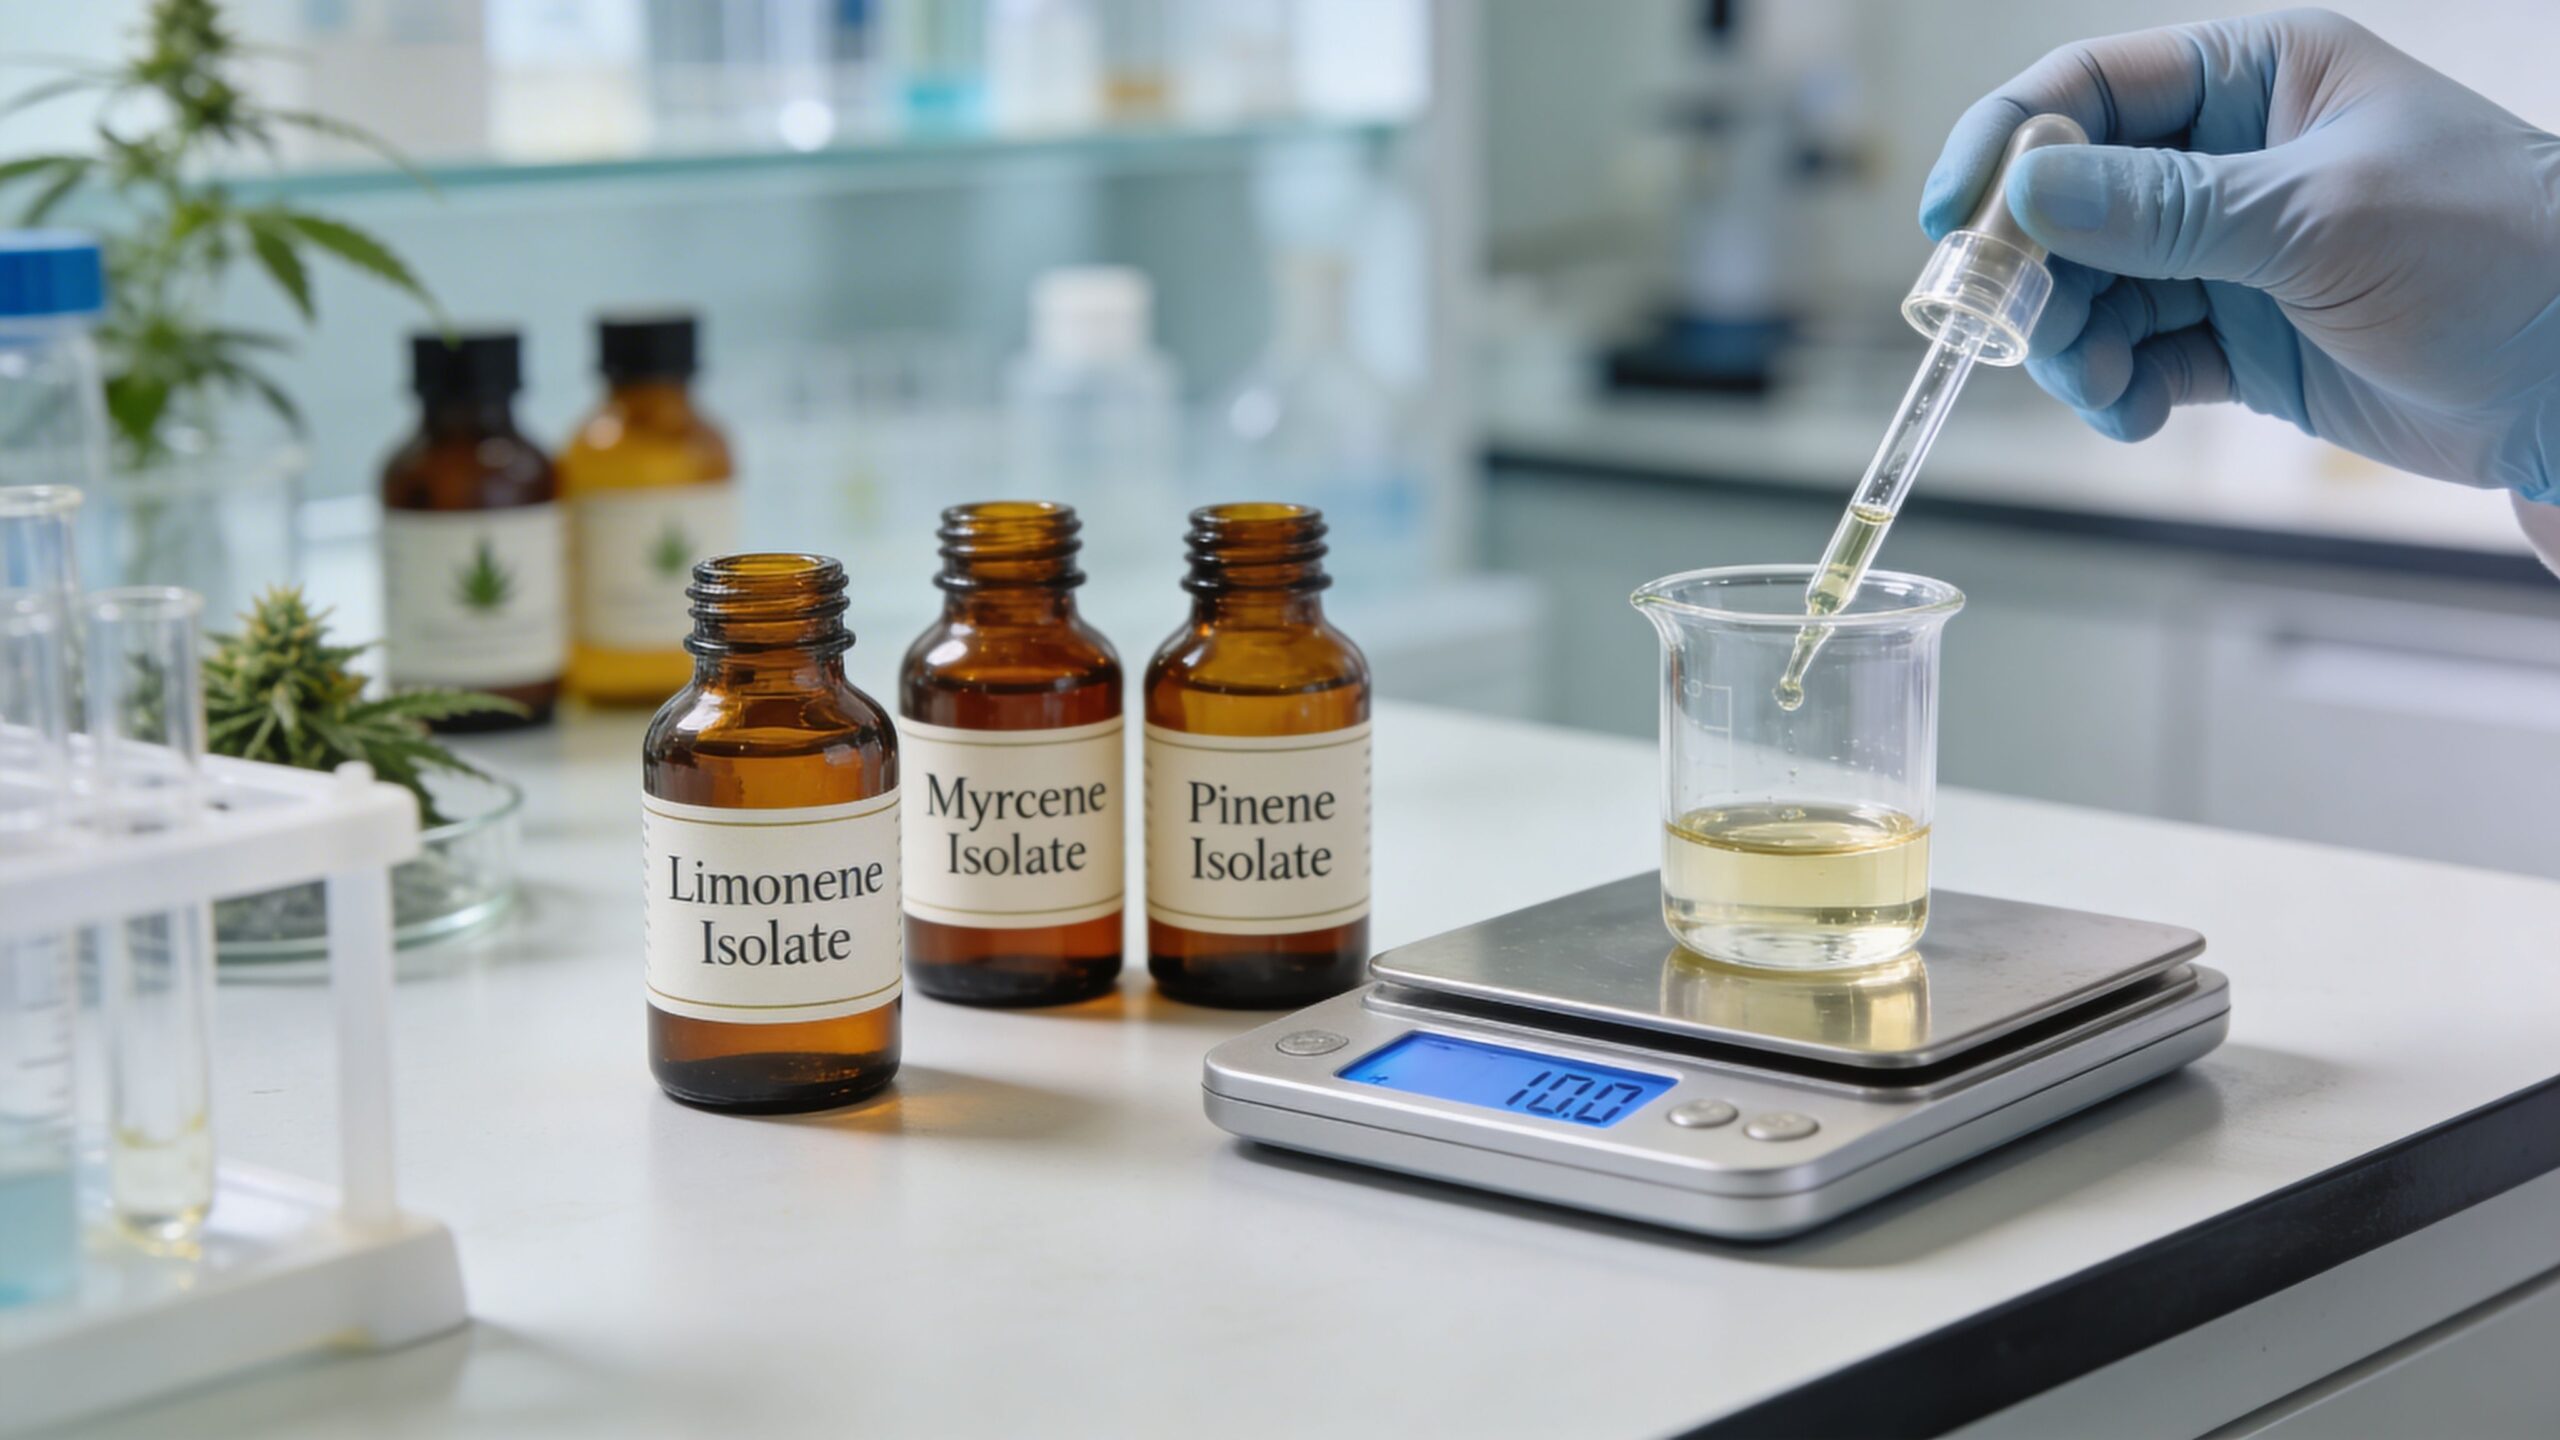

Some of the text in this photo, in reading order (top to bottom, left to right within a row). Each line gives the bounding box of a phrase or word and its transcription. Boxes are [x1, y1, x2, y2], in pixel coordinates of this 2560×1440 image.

[926, 772, 1109, 833] Myrcene
[1188, 780, 1337, 825] Pinene
[948, 831, 1088, 877] Isolate
[1191, 836, 1333, 882] Isolate
[667, 855, 884, 906] Limonene
[700, 918, 852, 967] Isolate
[1505, 1070, 1643, 1123] 10.0
